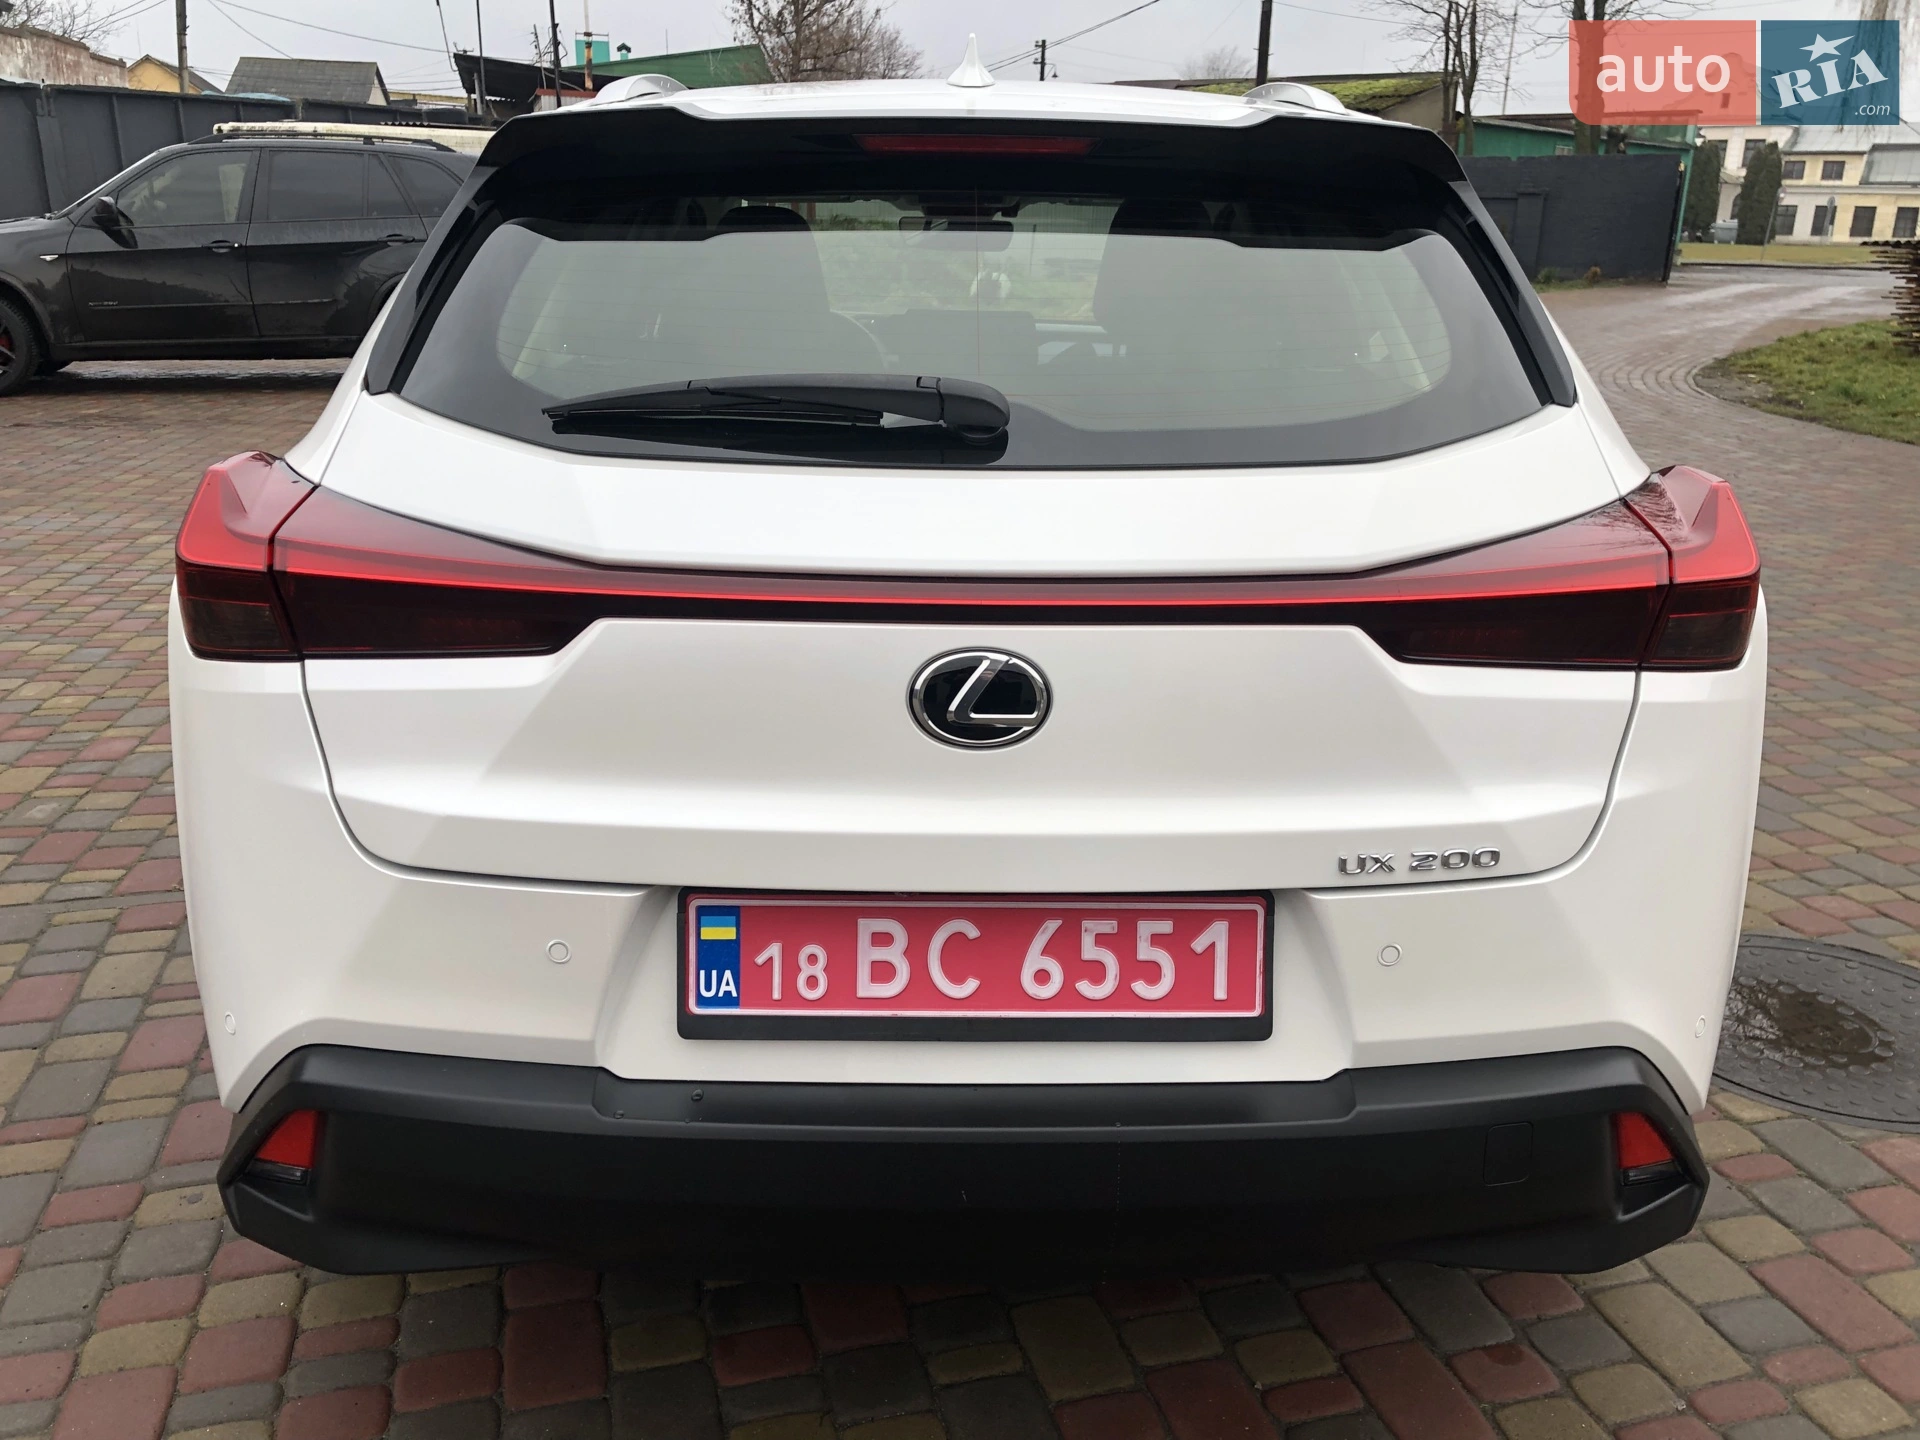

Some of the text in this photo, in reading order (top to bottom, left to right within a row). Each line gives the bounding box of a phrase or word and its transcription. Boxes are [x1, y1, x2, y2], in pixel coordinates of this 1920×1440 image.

[1338, 846, 1501, 875] UX 200
[753, 917, 1231, 1001] 18 BC 6551
[698, 969, 738, 998] UA
